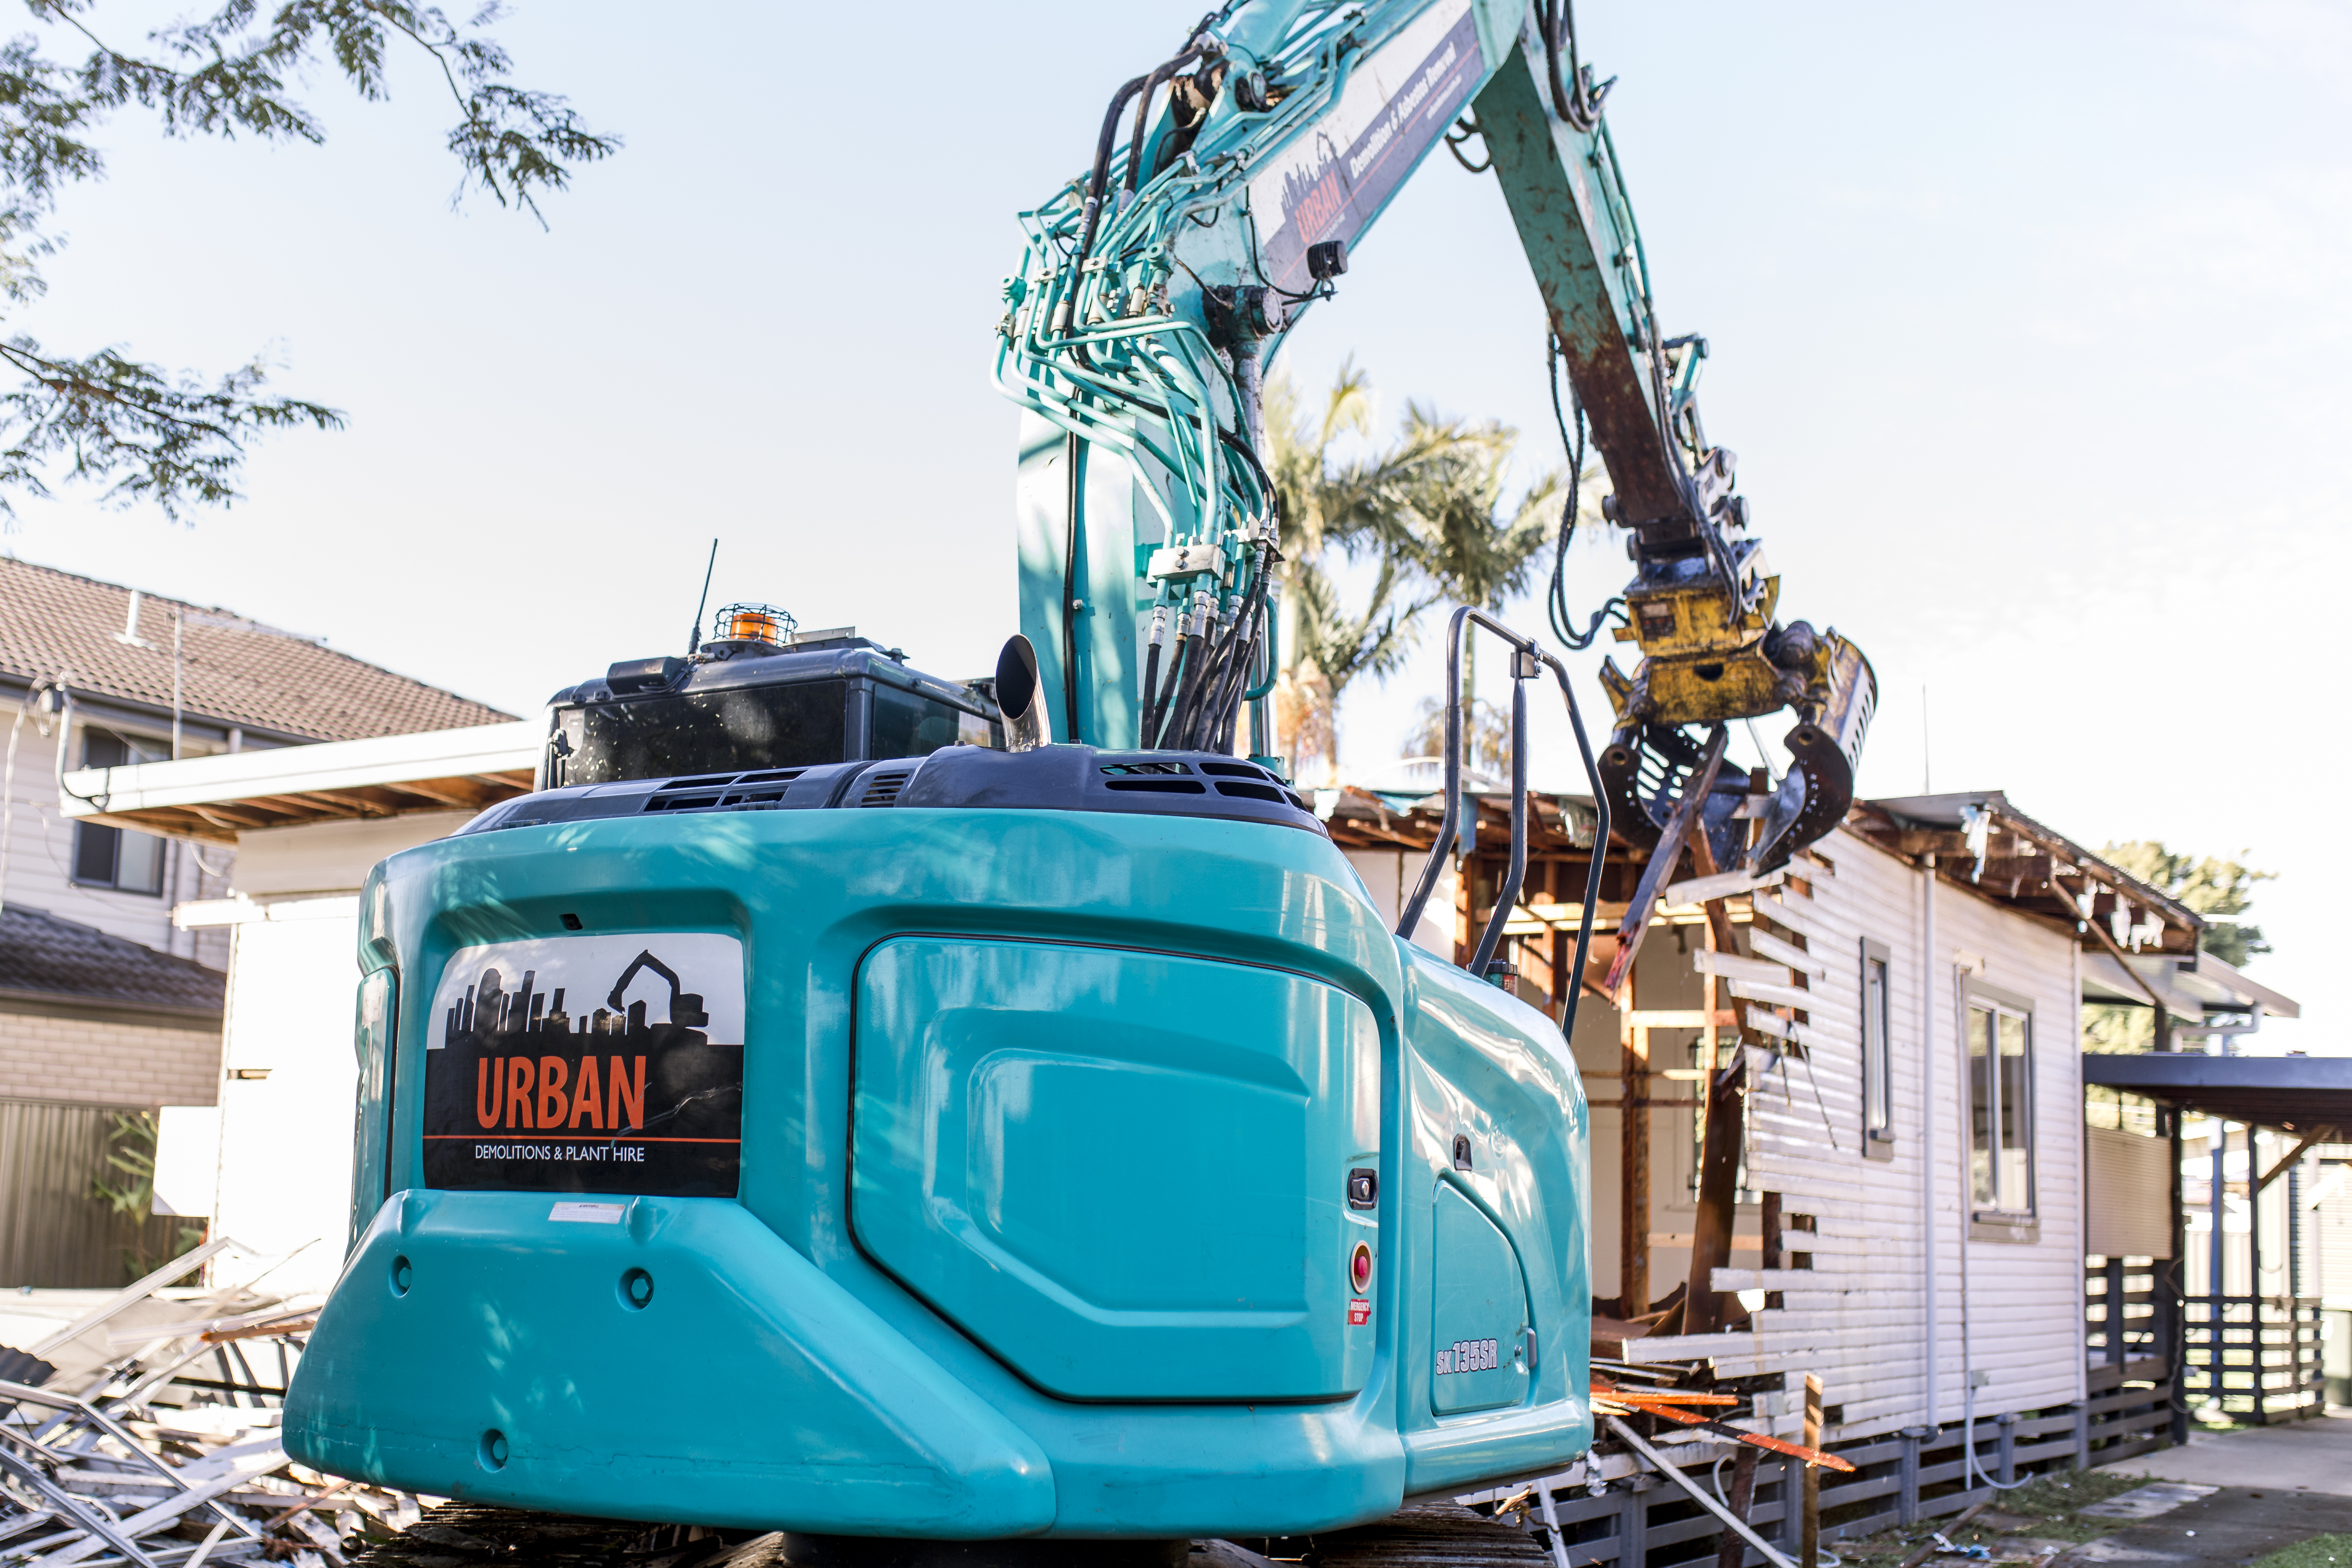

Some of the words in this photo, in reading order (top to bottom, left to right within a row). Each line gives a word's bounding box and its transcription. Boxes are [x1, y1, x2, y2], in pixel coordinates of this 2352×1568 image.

[1350, 121, 1393, 179] Demolition
[1390, 110, 1399, 131] &
[1397, 77, 1429, 123] Asbestos
[1425, 41, 1457, 88] Removal
[1295, 170, 1342, 244] URBAN
[477, 1056, 646, 1129] URBAN
[475, 1145, 551, 1160] DEMOLITIONS
[554, 1146, 562, 1160] &
[566, 1146, 609, 1161] PLANT
[613, 1147, 645, 1162] HIRE
[1350, 1301, 1369, 1311] MERGENCY
[1354, 1312, 1364, 1322] STOP
